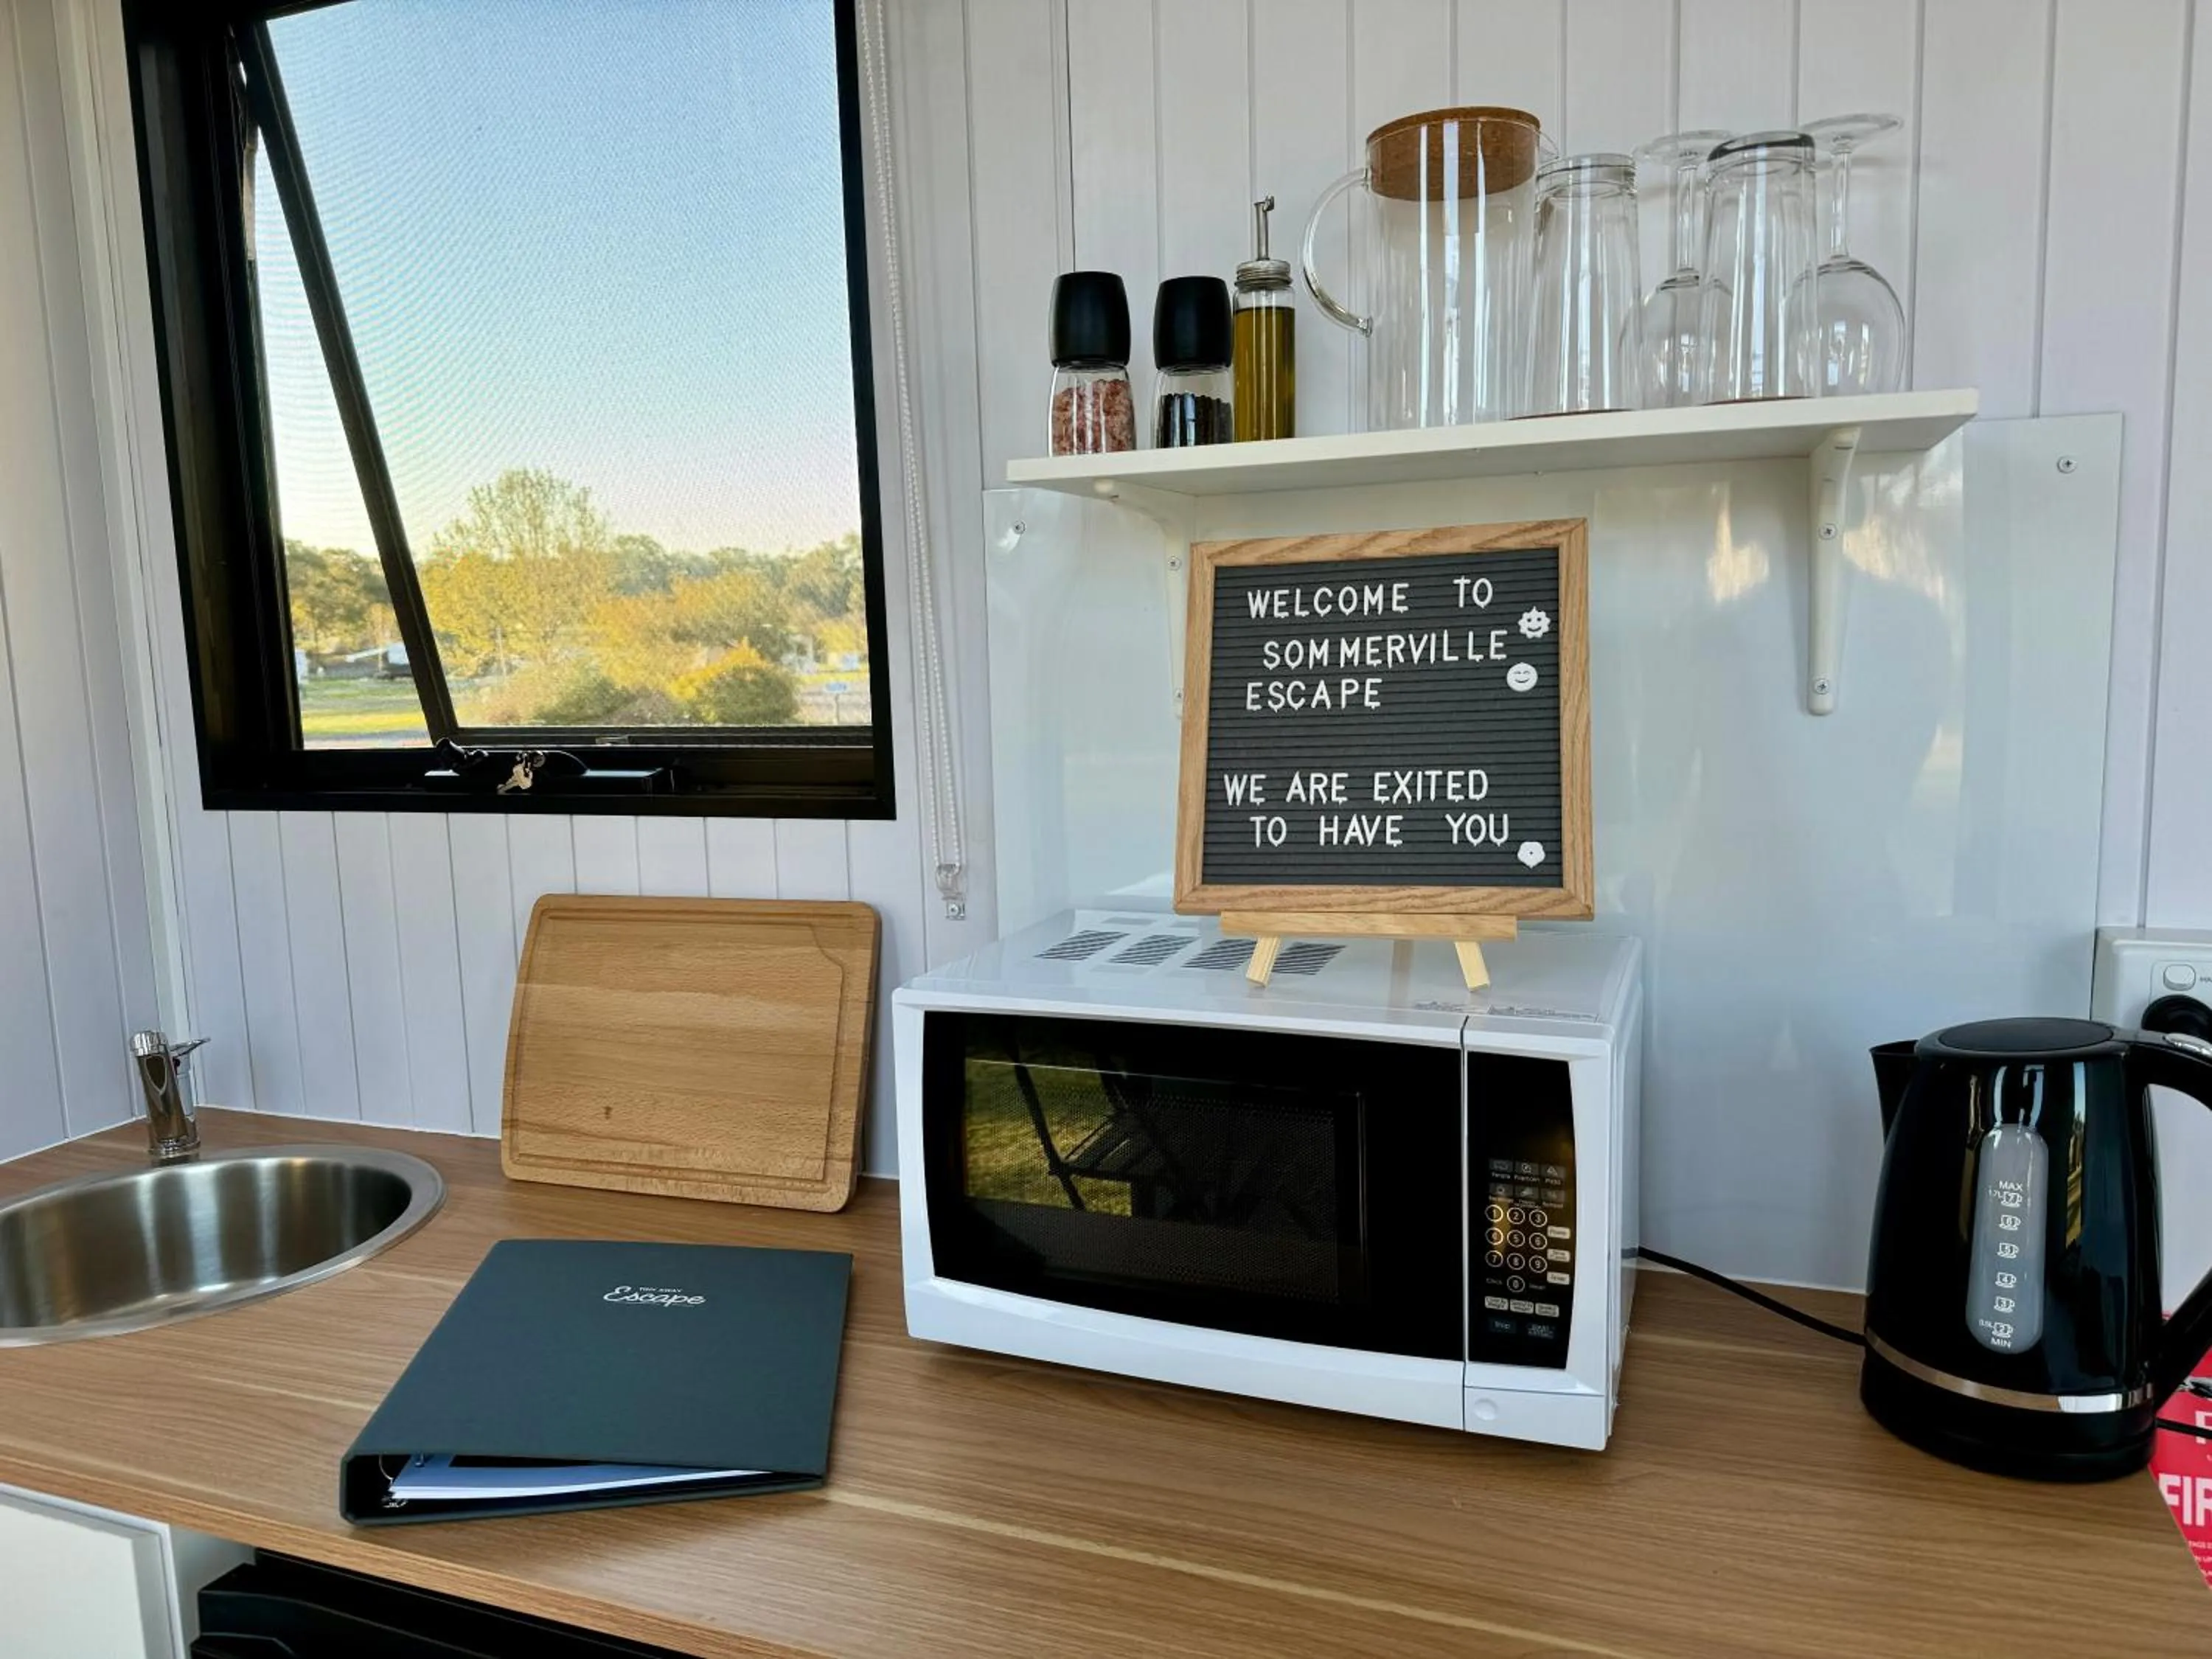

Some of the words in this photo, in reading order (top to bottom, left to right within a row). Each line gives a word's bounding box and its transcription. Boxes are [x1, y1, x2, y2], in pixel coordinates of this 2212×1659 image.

[1247, 583, 1409, 619] WELCOME
[1453, 576, 1493, 608] TO
[1262, 629, 1508, 670] SOMMERVILLE
[1246, 678, 1382, 712] ESCAPE
[1224, 773, 1267, 806] WE
[1285, 771, 1349, 805] ARE
[1373, 769, 1489, 804] EXITED
[1250, 815, 1287, 847] TO
[1319, 814, 1404, 847] HAVE
[1445, 813, 1509, 847] YOU
[1999, 1180, 2023, 1192] MAX
[603, 1285, 706, 1307] Escape
[1991, 1337, 2011, 1349] MIN
